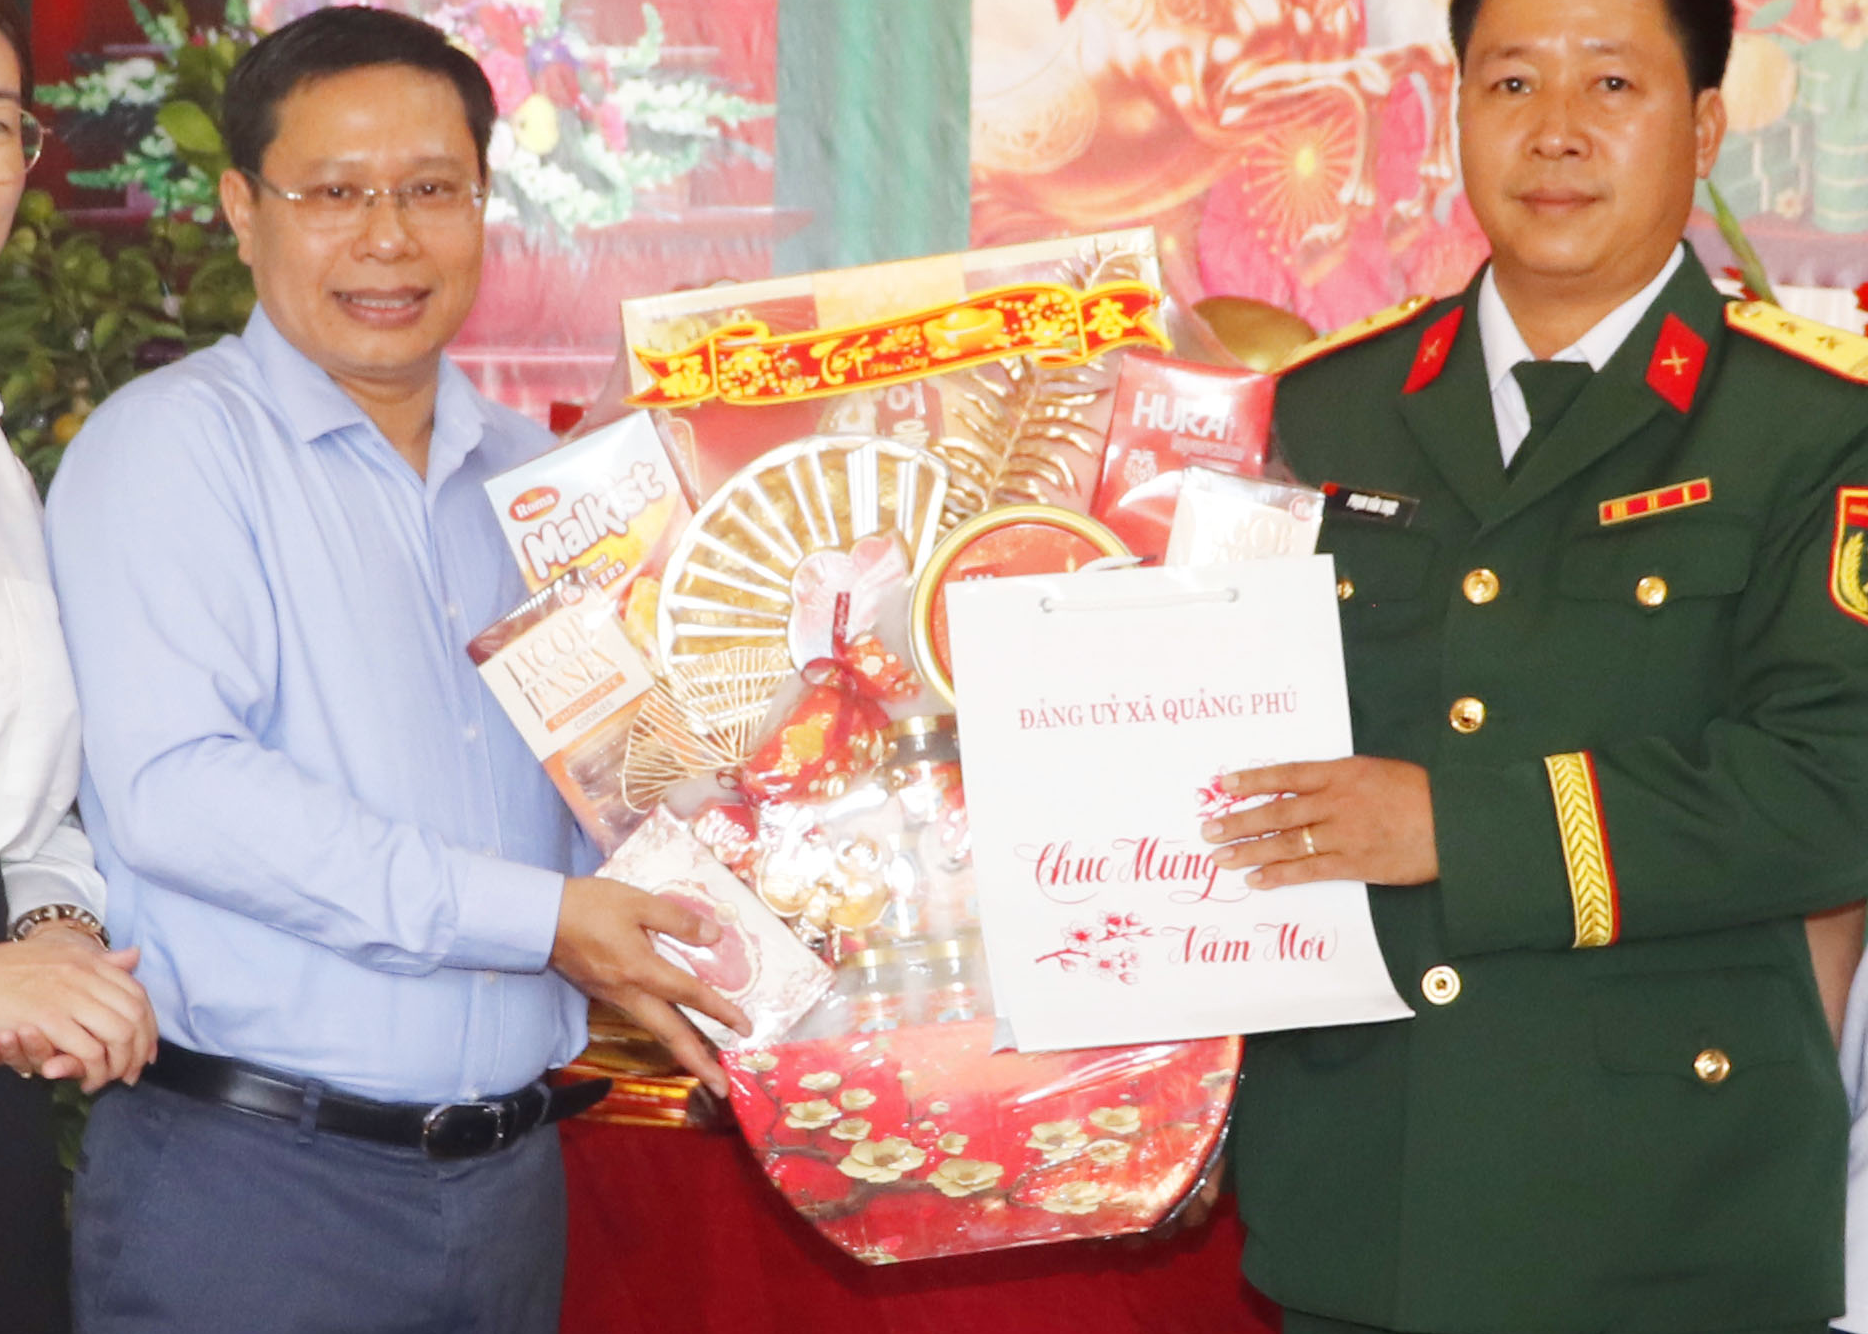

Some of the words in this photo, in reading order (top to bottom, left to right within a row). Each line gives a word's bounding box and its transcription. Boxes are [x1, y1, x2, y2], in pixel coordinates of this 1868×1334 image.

[515, 493, 556, 519] Roma
[521, 461, 666, 581] Malkist
[1018, 698, 1083, 730] ĐẢNG
[1126, 694, 1157, 723] XÃ
[1162, 688, 1244, 725] QUẢNG
[1251, 684, 1299, 716] PHÚ
